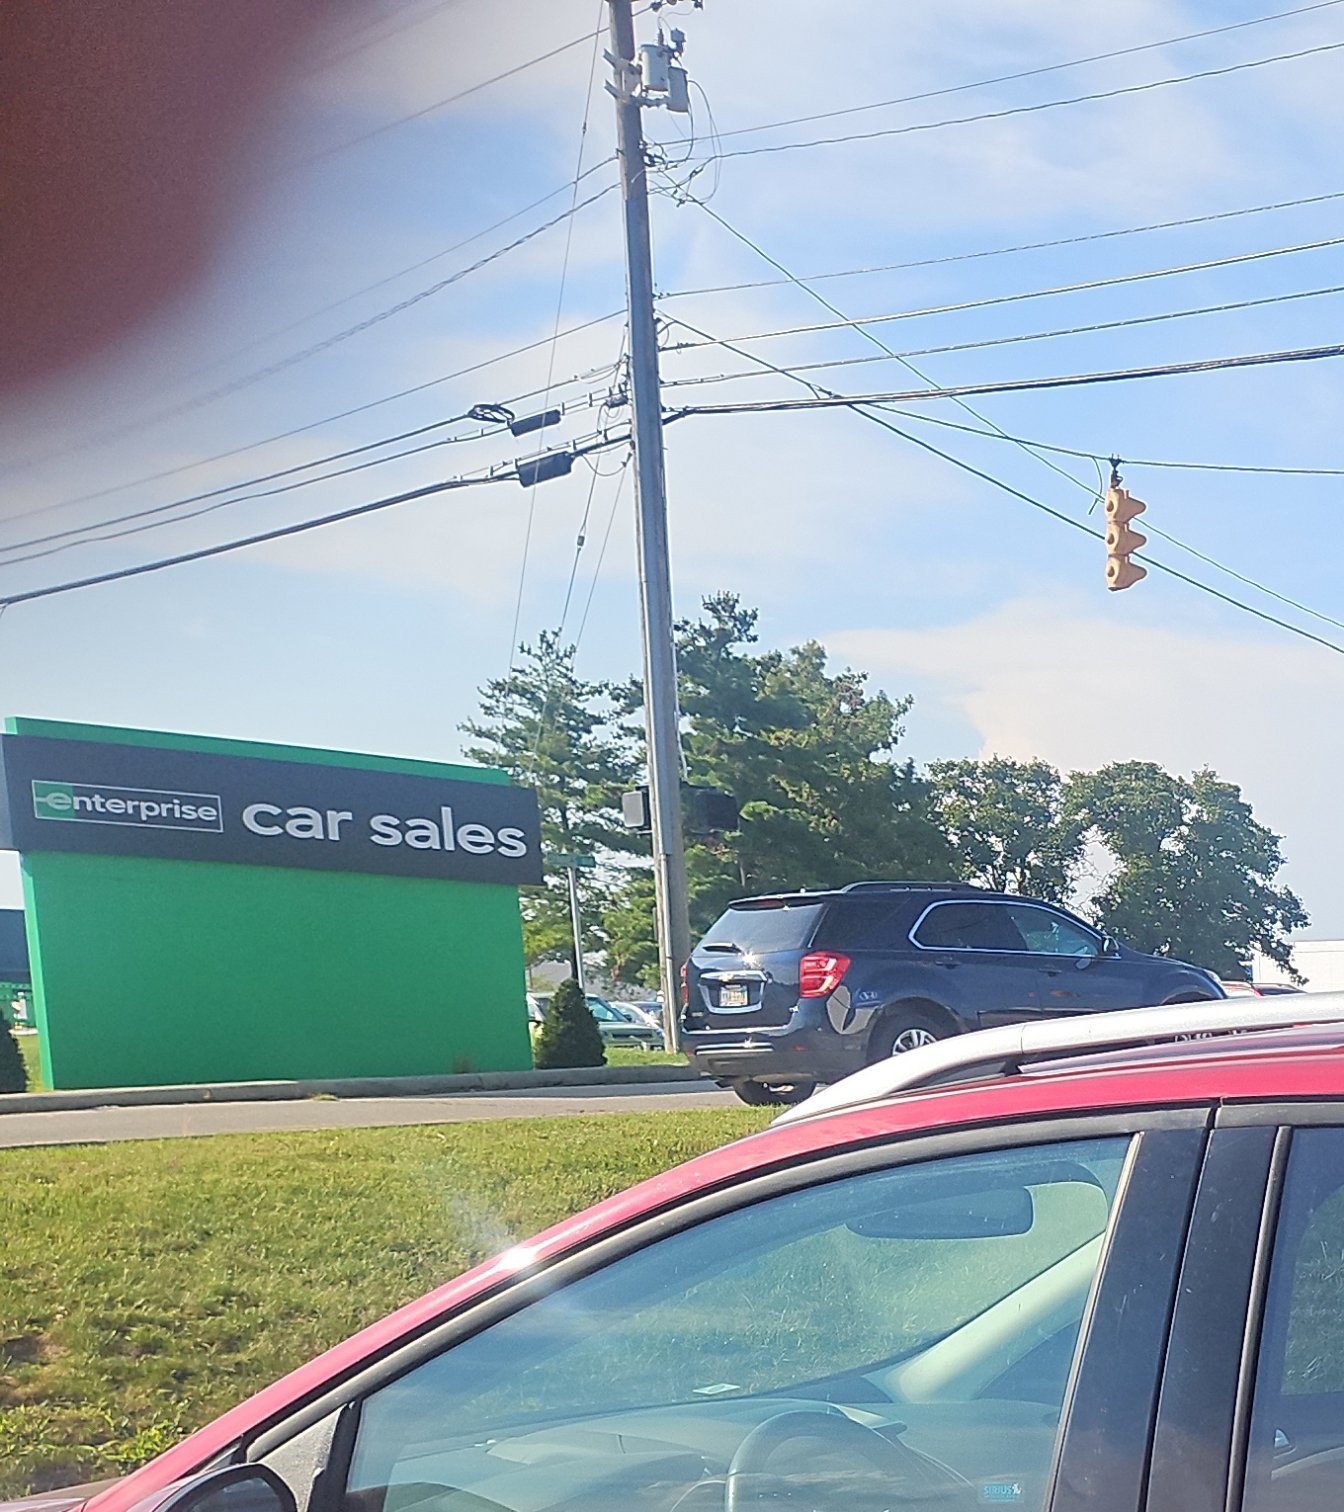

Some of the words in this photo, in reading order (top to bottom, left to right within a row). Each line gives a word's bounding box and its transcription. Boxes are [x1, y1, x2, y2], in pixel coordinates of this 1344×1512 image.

[45, 791, 218, 821] enterprise
[242, 803, 353, 841] car
[369, 806, 528, 858] sales
